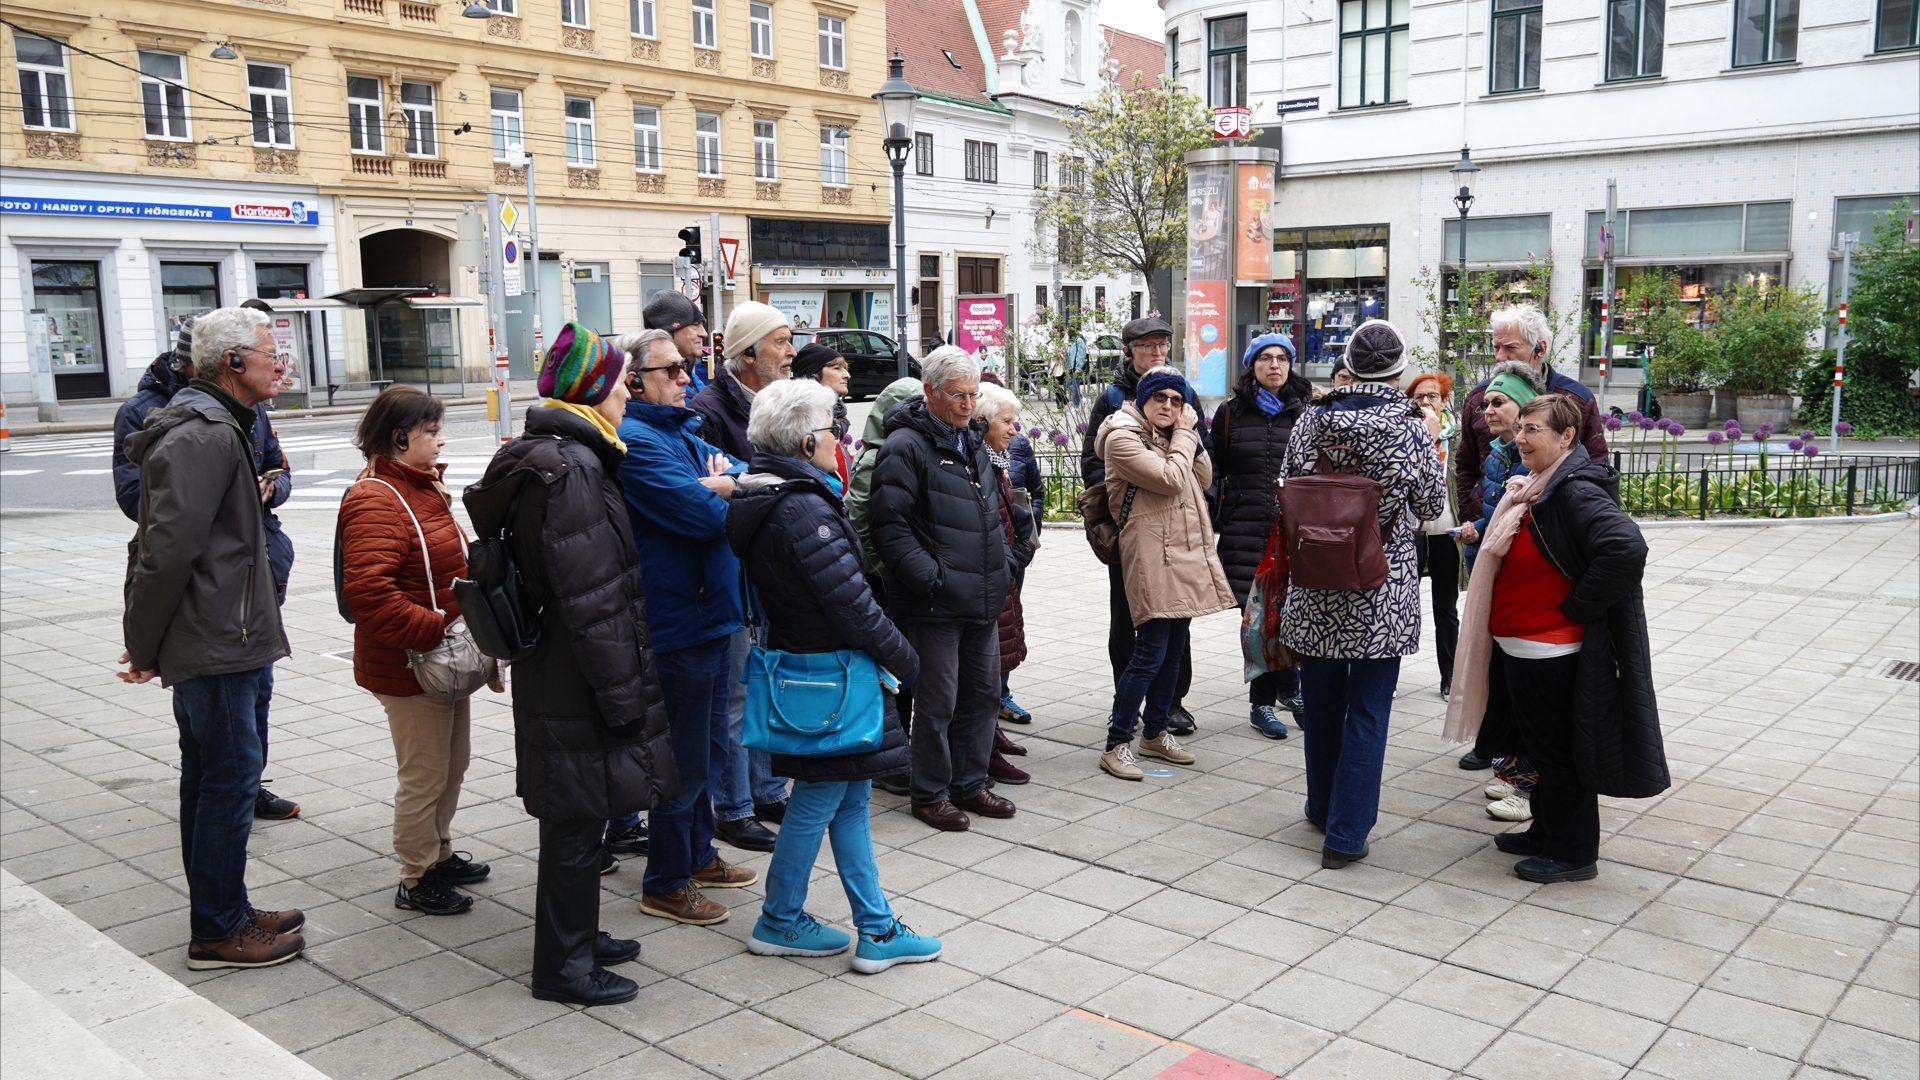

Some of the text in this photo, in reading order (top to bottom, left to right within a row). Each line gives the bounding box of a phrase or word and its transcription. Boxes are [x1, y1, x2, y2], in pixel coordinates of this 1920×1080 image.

[1198, 187, 1207, 196] BIS
[1208, 187, 1219, 195] ZU
[42, 203, 87, 212] HANDY
[97, 205, 134, 214] OPTIK
[144, 206, 213, 218] HÖRGERÄTE
[238, 205, 288, 218] Hartlauer
